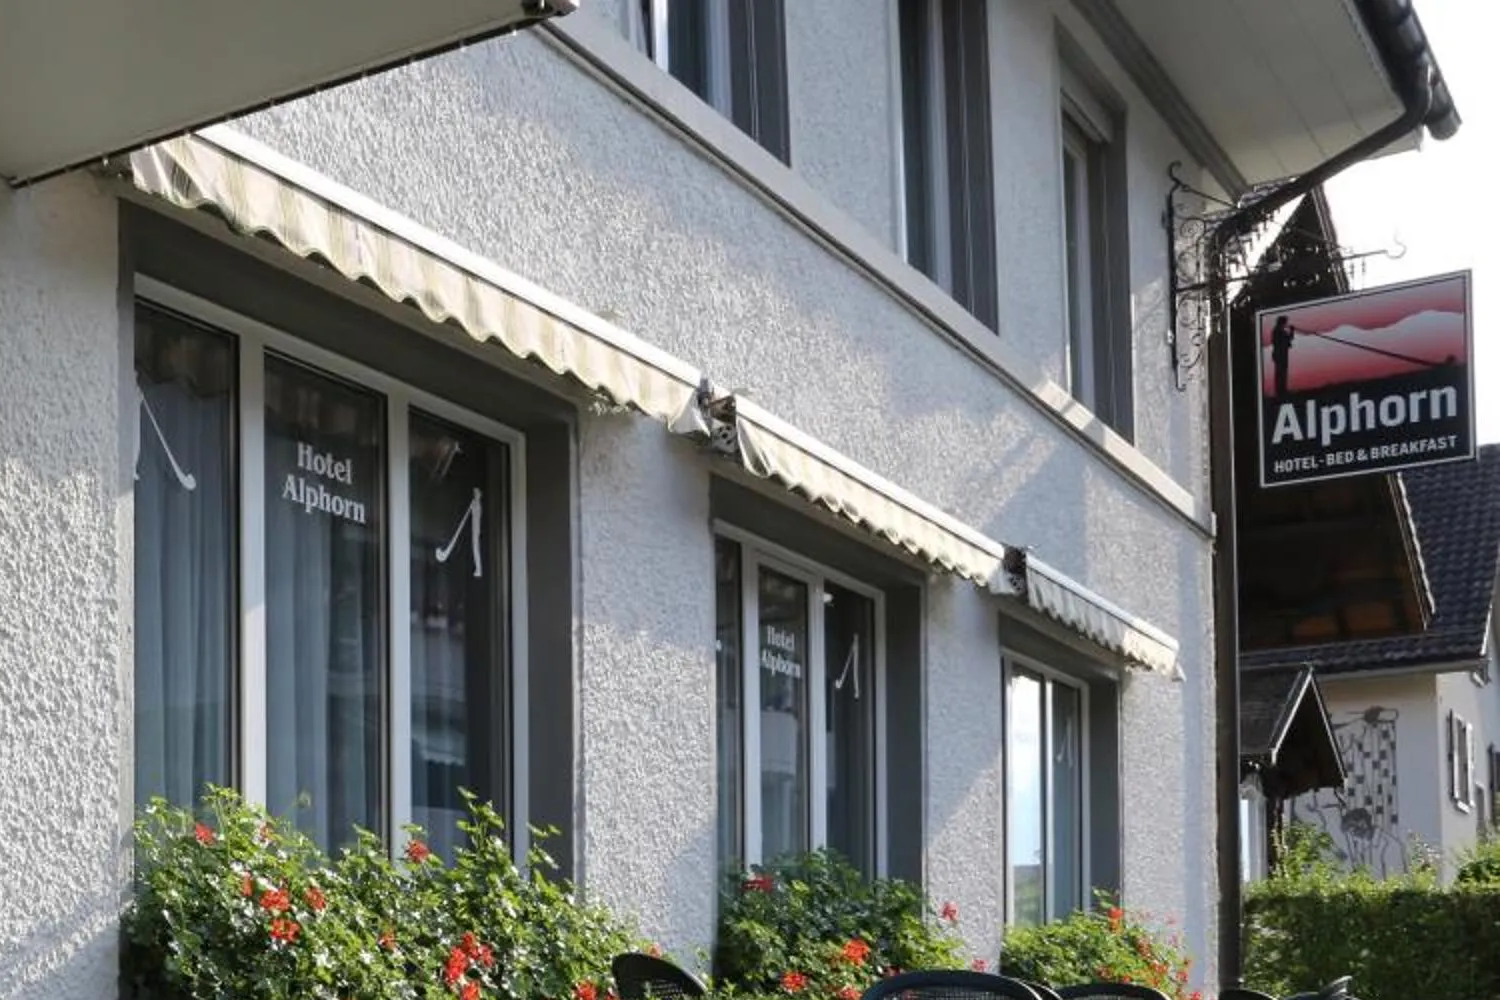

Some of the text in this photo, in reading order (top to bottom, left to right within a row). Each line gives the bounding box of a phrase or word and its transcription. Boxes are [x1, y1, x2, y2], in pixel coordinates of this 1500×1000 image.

[1272, 385, 1457, 446] Alphorn
[297, 441, 354, 485] Hotel
[1356, 449, 1368, 461] &
[1370, 435, 1457, 459] BREAKFAST
[281, 473, 366, 525] Alphorn
[767, 624, 795, 652] Hotel
